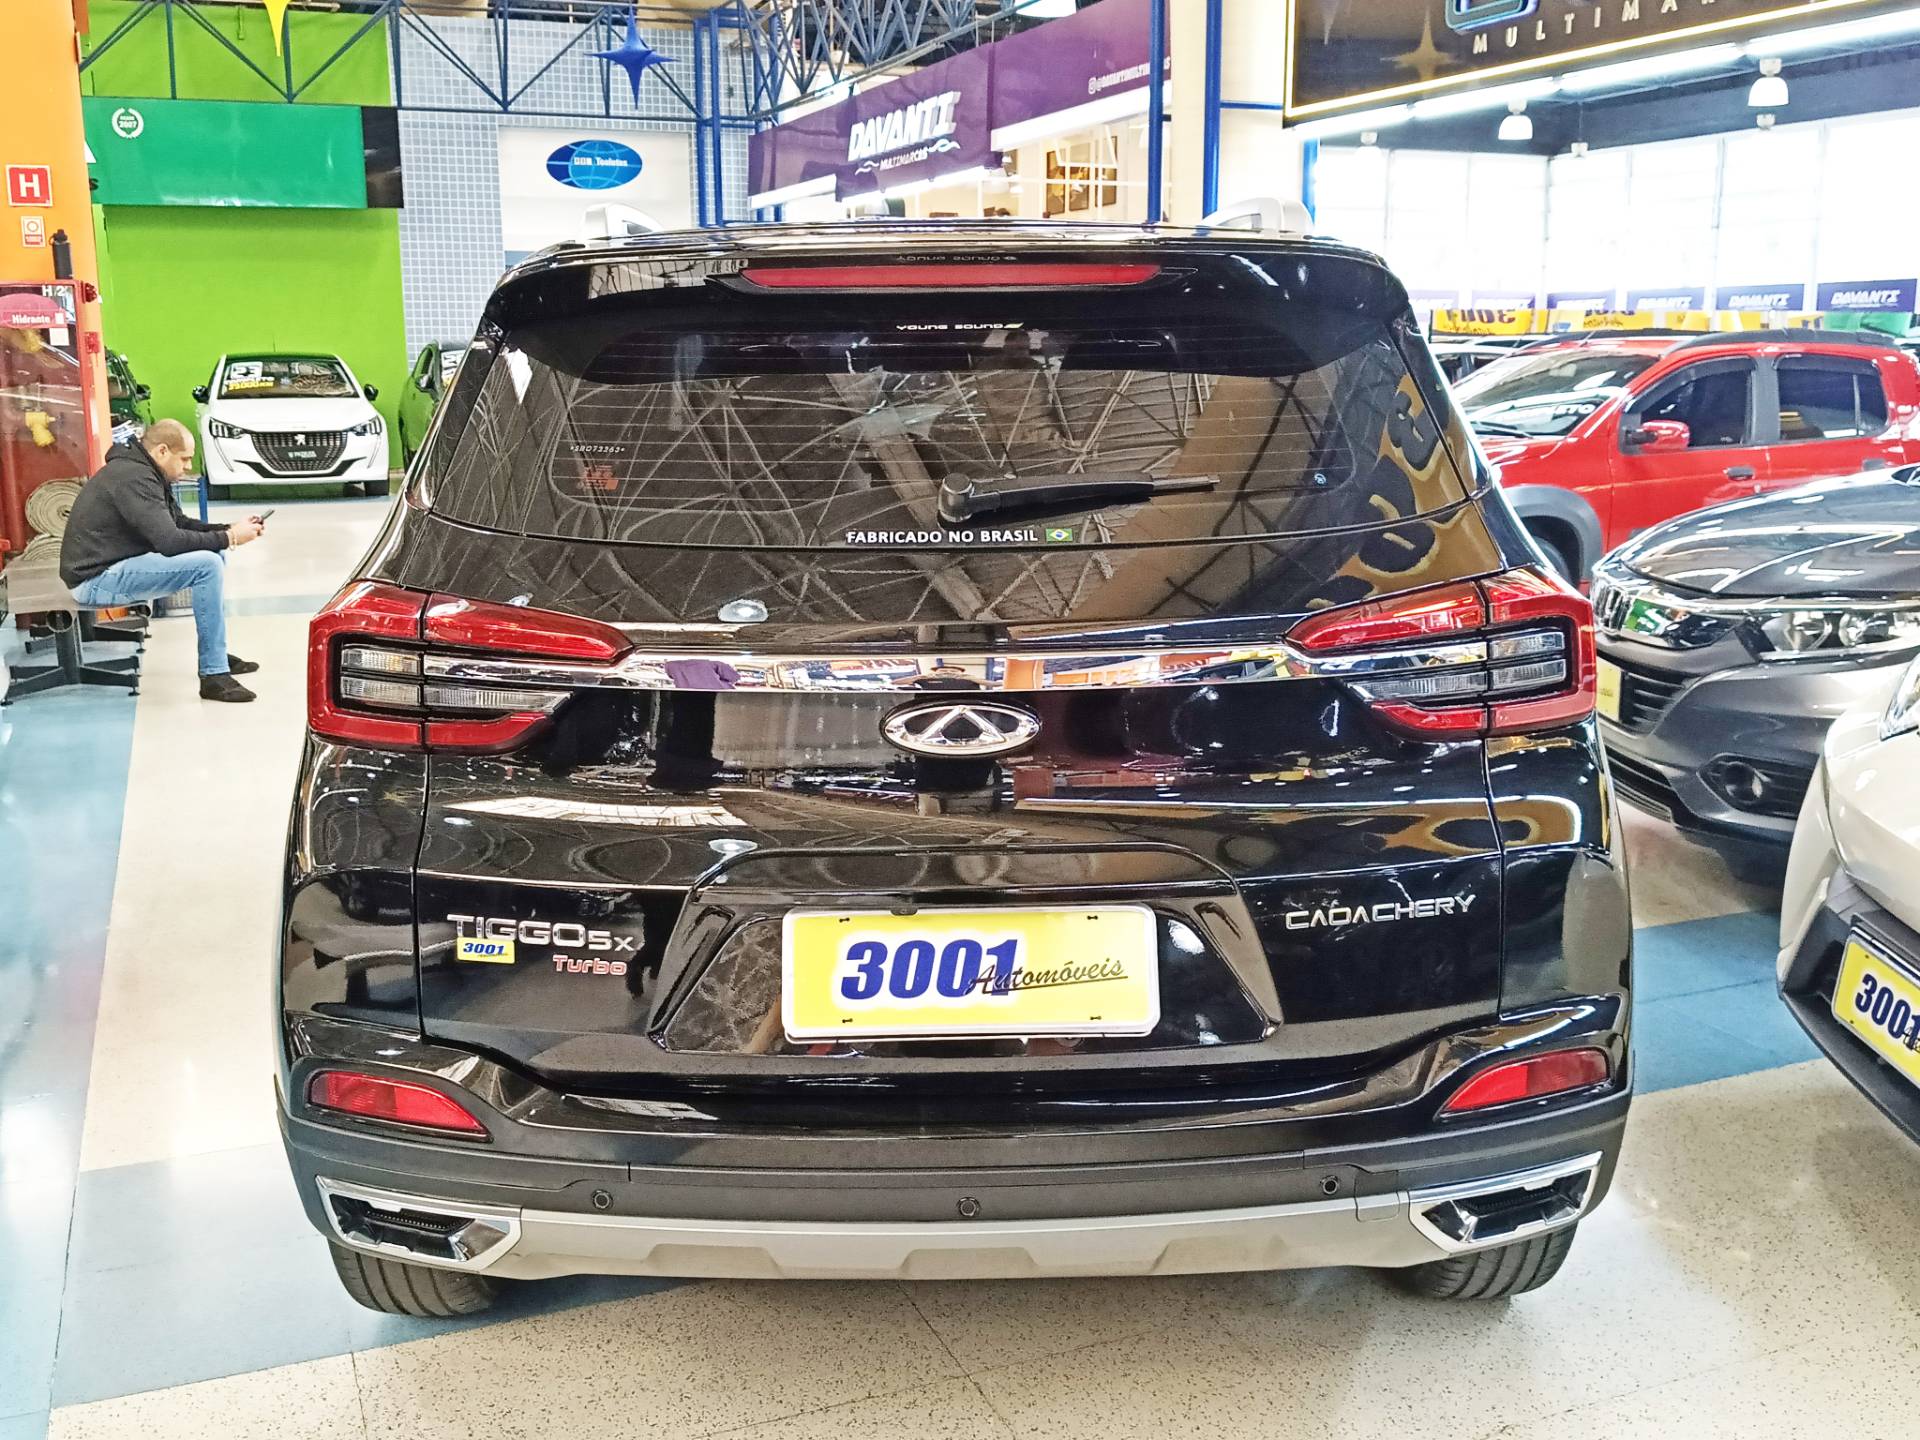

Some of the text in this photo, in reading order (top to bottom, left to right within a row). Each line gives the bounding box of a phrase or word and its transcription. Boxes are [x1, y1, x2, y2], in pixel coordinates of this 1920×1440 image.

[1472, 0, 1716, 55] MULTIMA
[848, 90, 961, 162] DAVANTI
[18, 172, 41, 198] H
[41, 284, 53, 297] H
[1830, 289, 1901, 305] DAVANTI
[11, 314, 51, 324] Hidrante
[847, 529, 1039, 544] FABRICADO NO BRASIL
[463, 942, 505, 955] 3001
[552, 955, 628, 976] Turbo
[841, 938, 1128, 1001] 3001 Automóveis
